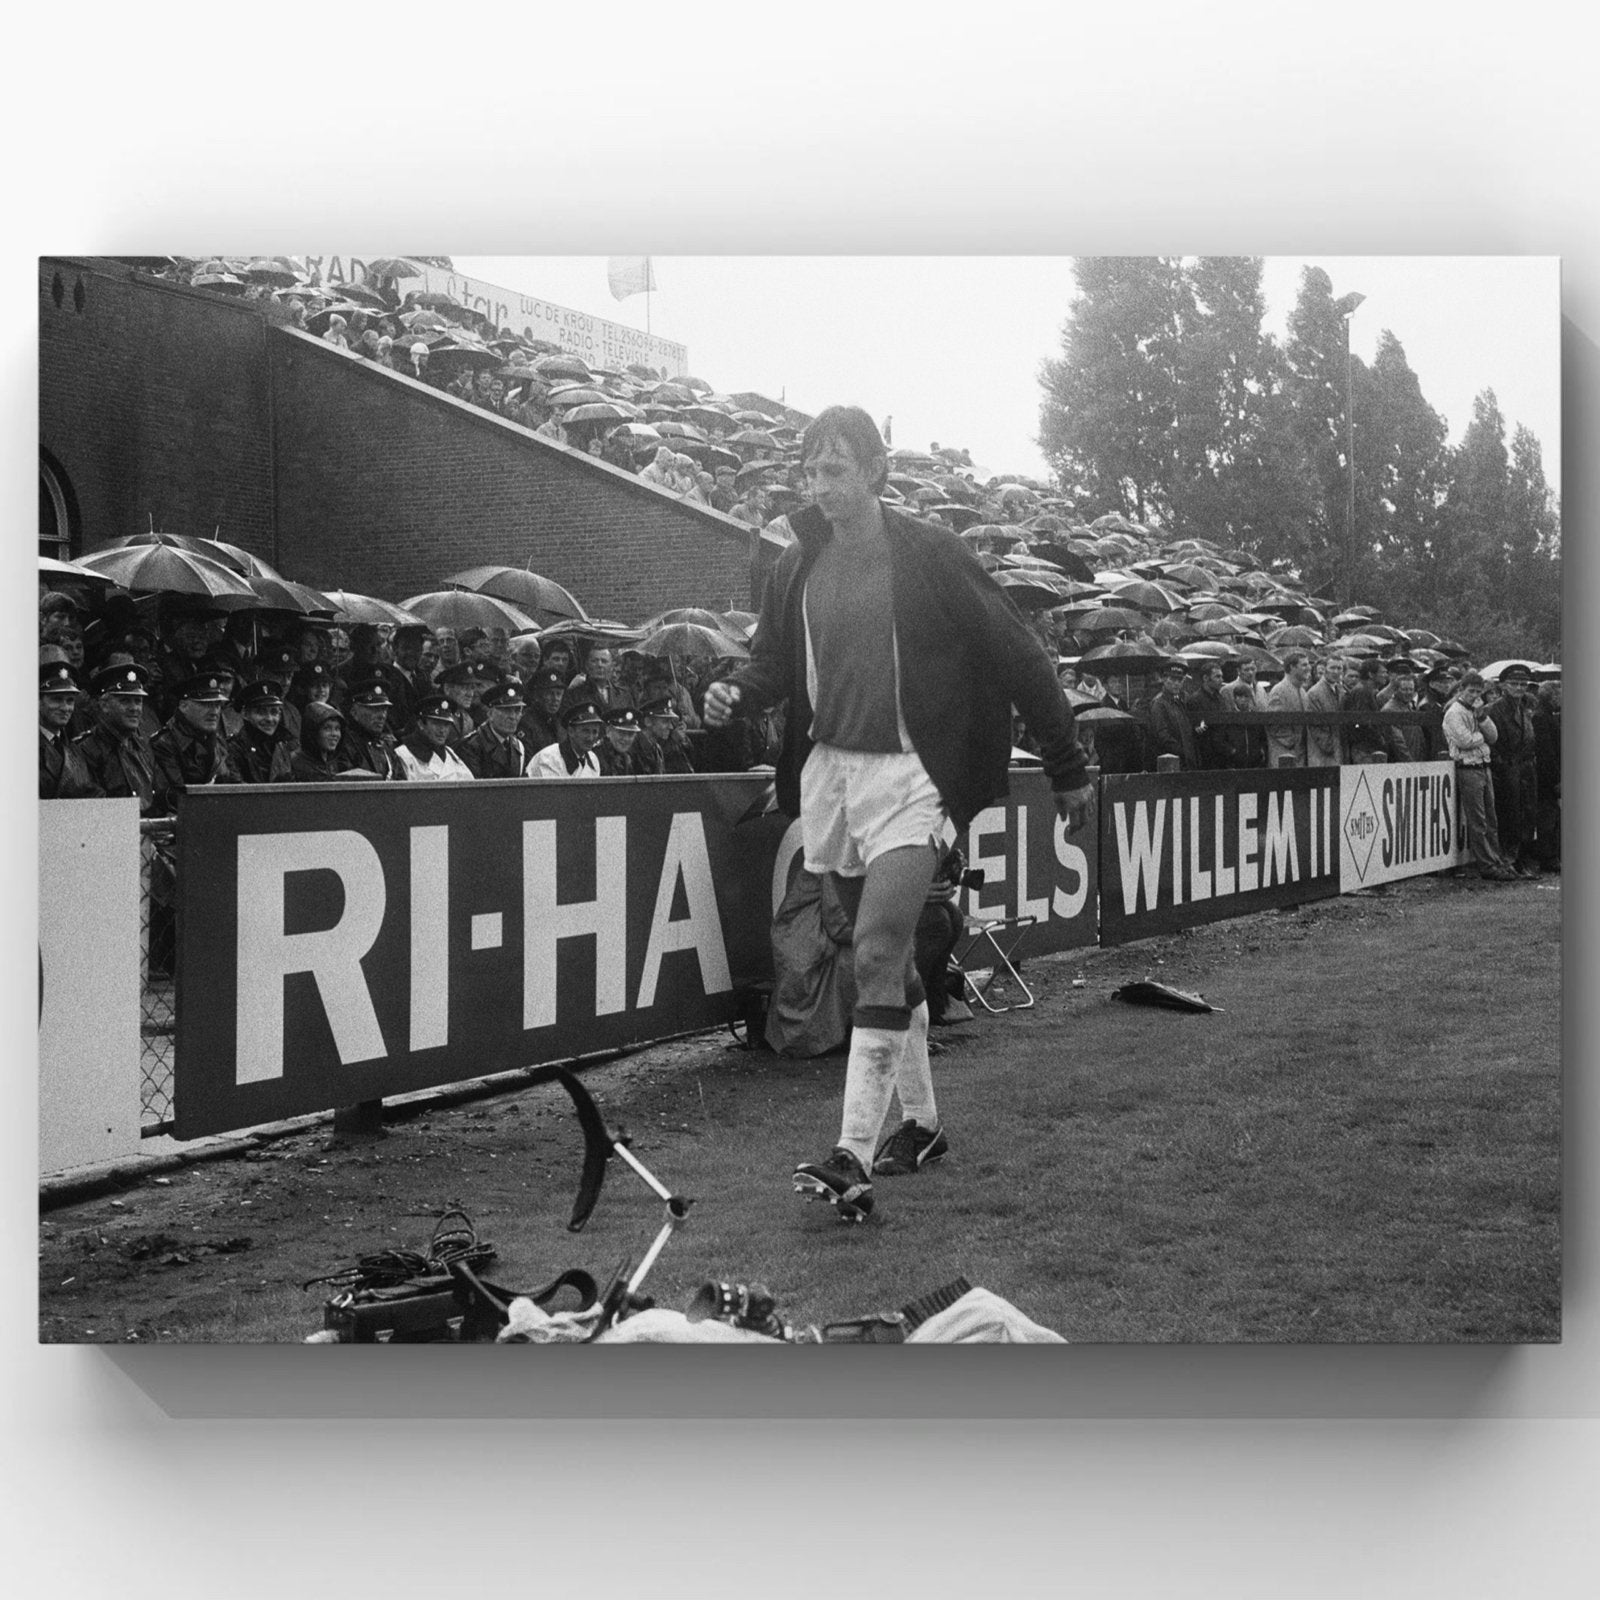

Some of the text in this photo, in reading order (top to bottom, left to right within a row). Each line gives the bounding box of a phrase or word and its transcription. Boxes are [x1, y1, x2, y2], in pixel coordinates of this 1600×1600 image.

[520, 297, 541, 318] LUC
[545, 306, 560, 324] DE
[559, 327, 593, 350] RADIO
[602, 340, 649, 364] TELEVISIE
[1113, 787, 1331, 916] WILLEM II
[1382, 773, 1452, 869] SMITHS
[235, 811, 734, 1087] RI-HA
